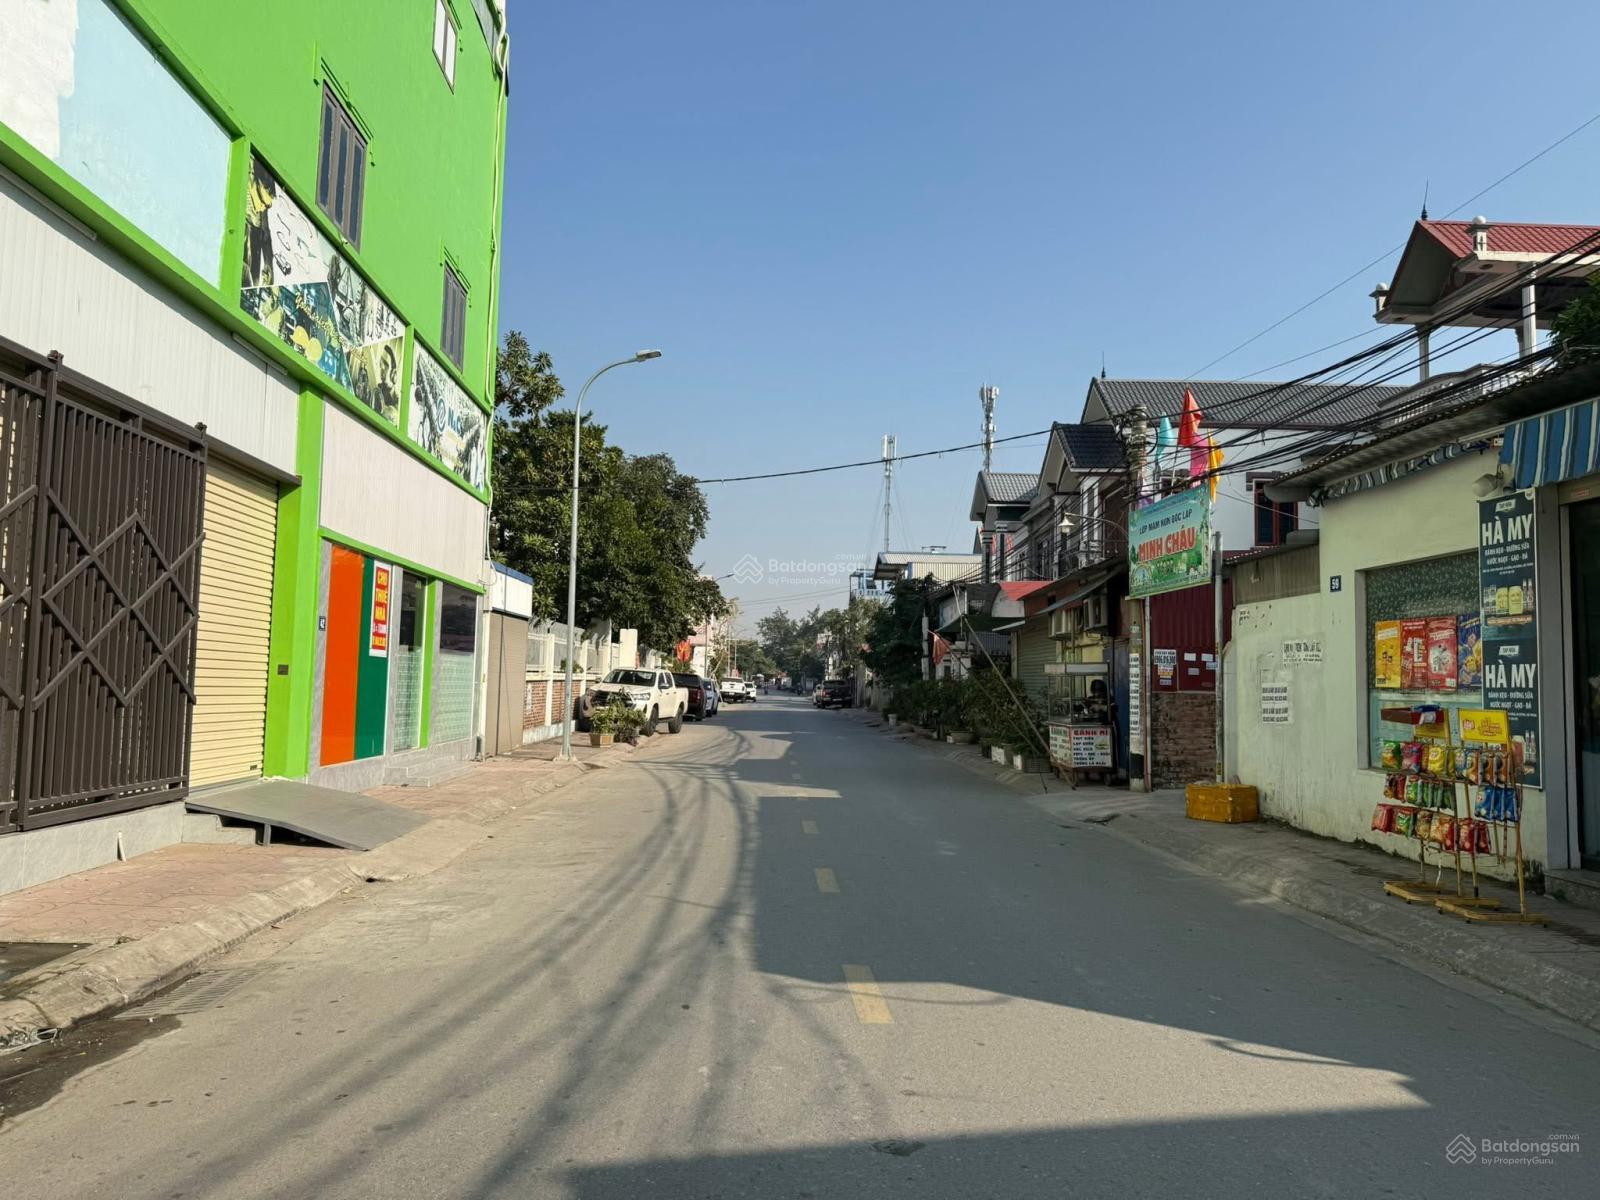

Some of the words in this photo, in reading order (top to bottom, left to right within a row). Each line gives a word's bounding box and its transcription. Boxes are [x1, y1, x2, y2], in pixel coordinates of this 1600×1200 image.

[1482, 515, 1504, 547] HÀ
[1507, 513, 1533, 542] MY
[1137, 537, 1164, 562] MINH
[1331, 578, 1340, 590] 59
[1485, 659, 1507, 689] HÀ
[1511, 663, 1537, 689] MY
